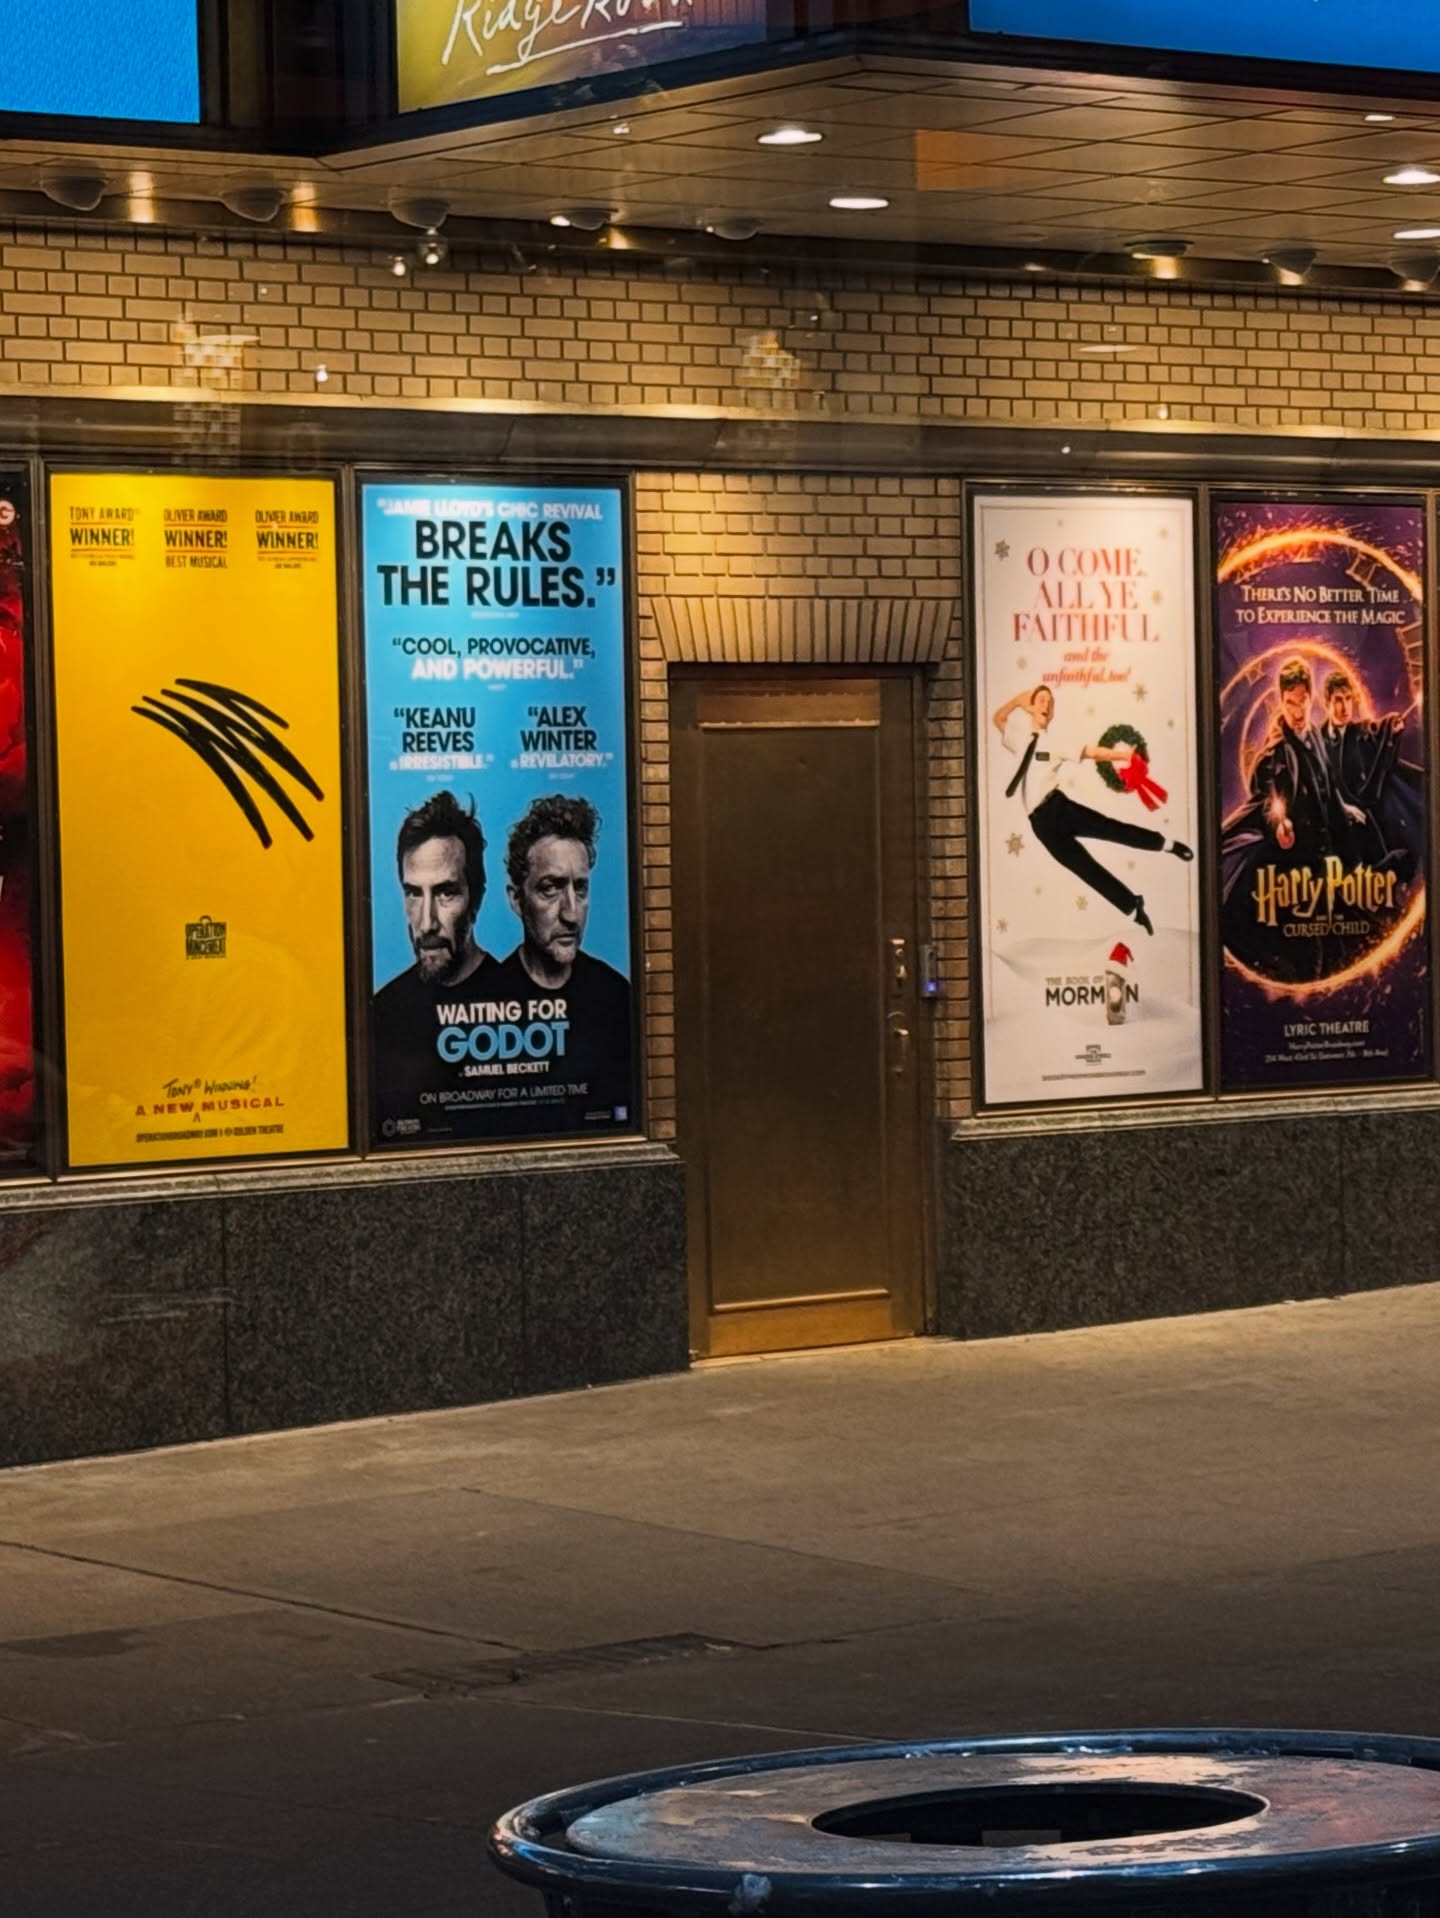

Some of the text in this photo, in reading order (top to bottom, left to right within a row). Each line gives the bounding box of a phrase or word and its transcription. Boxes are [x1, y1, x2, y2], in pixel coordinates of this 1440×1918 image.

[542, 504, 603, 520] REVIVAL
[70, 528, 134, 546] WINNER!
[164, 530, 228, 548] WINNER!
[256, 531, 319, 549] WINNER!
[415, 520, 571, 562] BREAKS
[165, 555, 228, 569] BEST MUSICAL
[1027, 548, 1050, 576] O
[377, 565, 616, 608] THE RULES.”
[1033, 580, 1139, 609] ALL YE
[1294, 586, 1317, 602] NO
[1319, 586, 1364, 603] BETTER
[1366, 587, 1399, 603] TIME
[1257, 607, 1331, 624] EXPERIENCE
[1361, 610, 1406, 625] MAGIC
[1013, 613, 1160, 642] FAITHFUL
[392, 637, 596, 658] “COOL, PROVOCATIVE,
[411, 659, 457, 680] AND
[393, 707, 476, 729] “KEANU
[528, 706, 587, 728] “ALEX
[402, 731, 475, 753] REEVES
[520, 730, 598, 752] WINTER
[1251, 855, 1397, 928] Harry Potter
[1283, 920, 1370, 937] CURSED CHILD
[436, 999, 567, 1025] WAITING FOR
[1284, 1020, 1369, 1037] LYRIC THEATRE
[437, 1020, 570, 1063] GODOT
[464, 1064, 505, 1077] SAMUEL
[507, 1061, 550, 1074] BECKETT
[419, 1092, 437, 1105] ON
[439, 1089, 497, 1104] BROADWAY
[499, 1087, 518, 1099] FOR
[520, 1086, 527, 1097] A
[530, 1085, 566, 1097] LIMITED
[568, 1083, 589, 1094] TIME
[135, 1096, 285, 1116] A NEW MUSICAL
